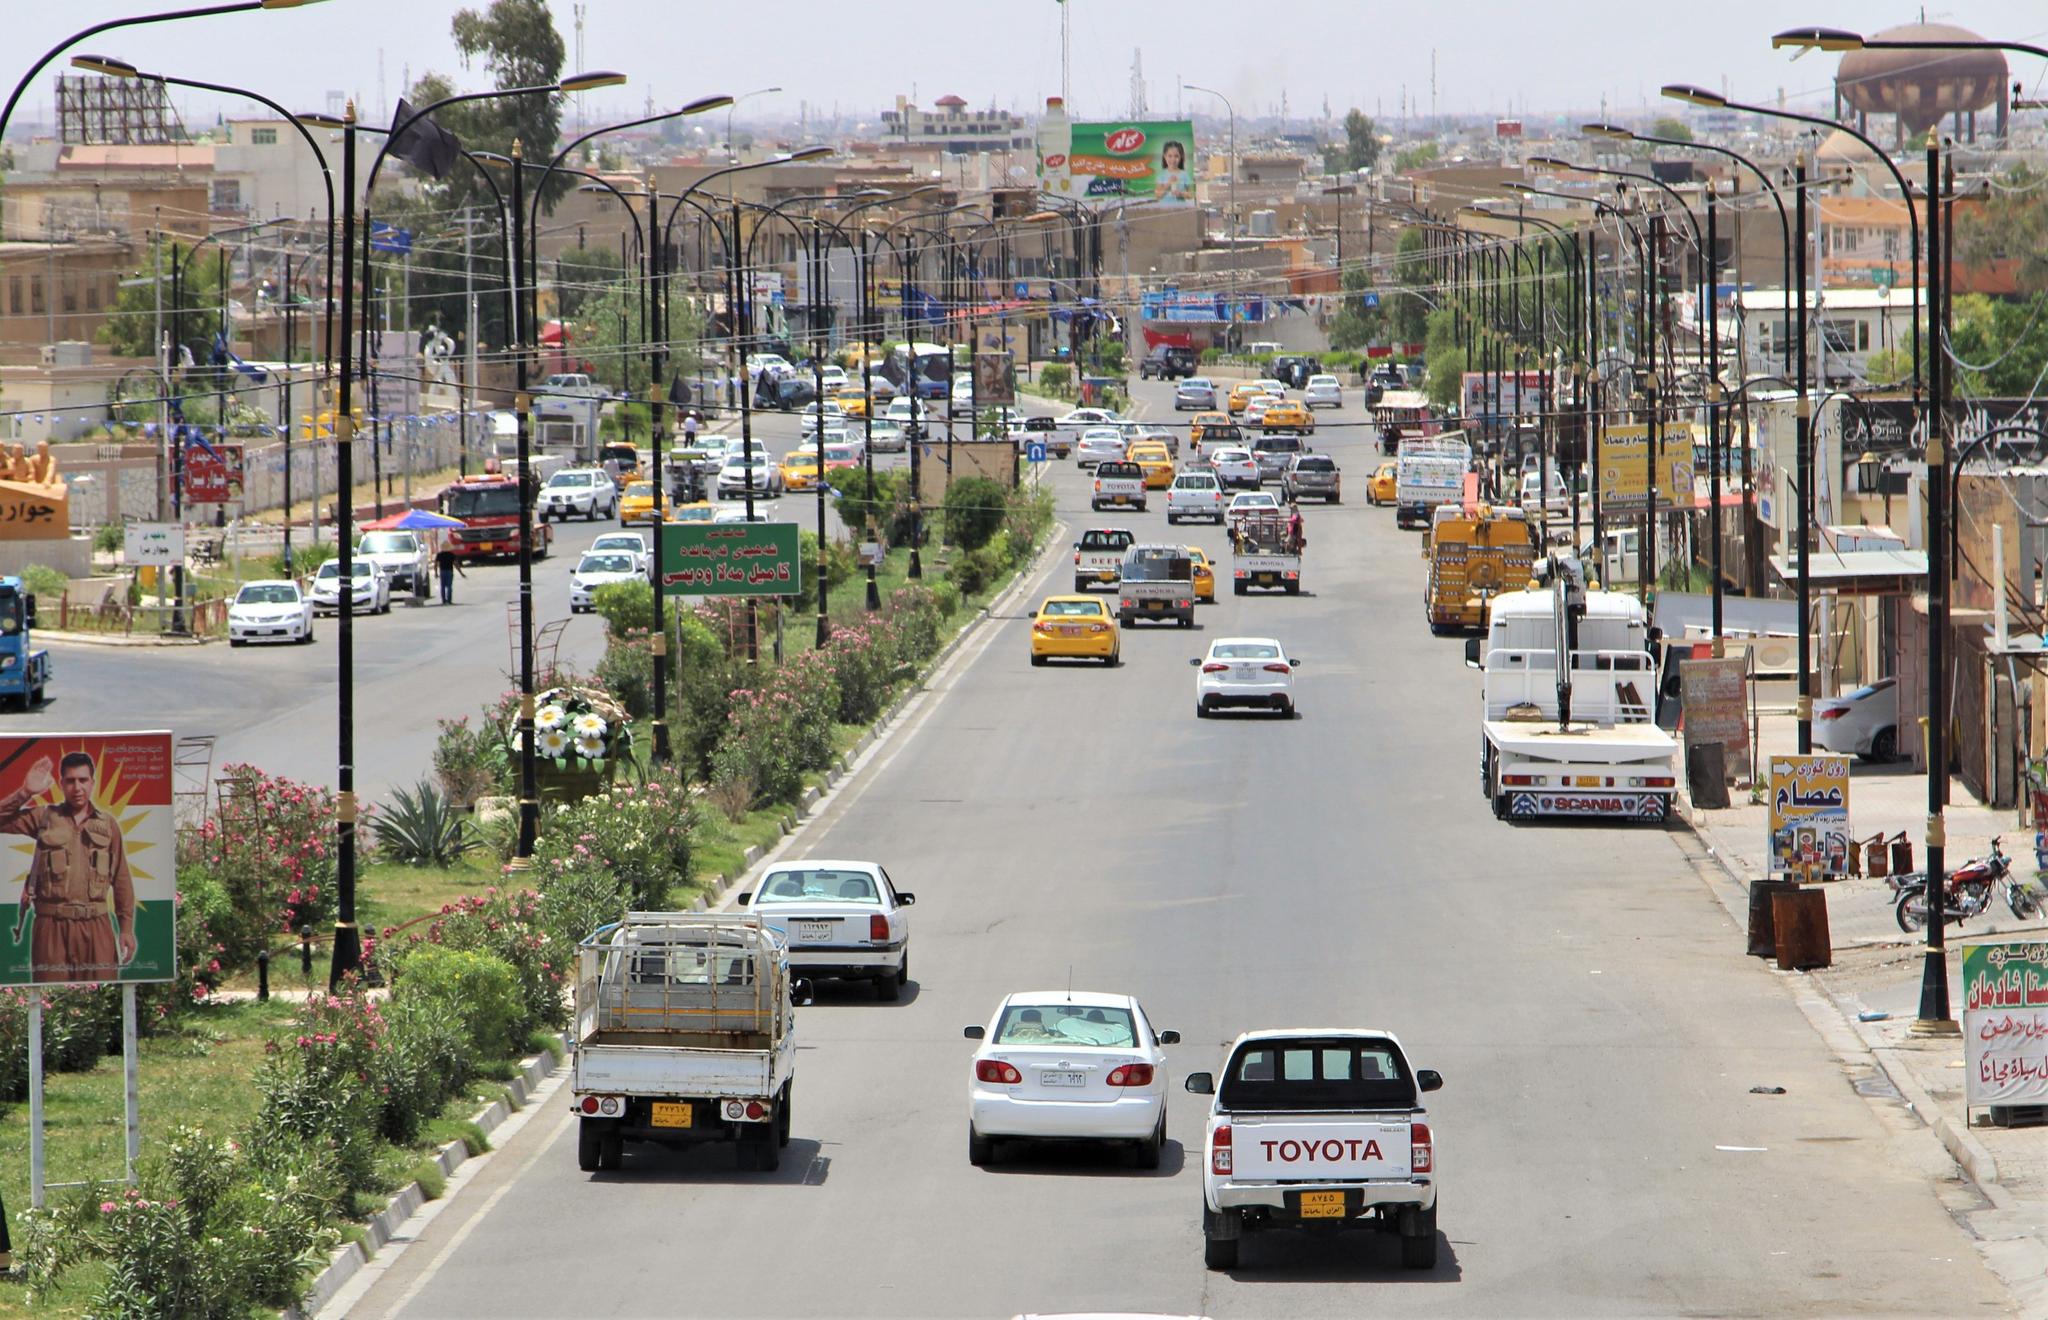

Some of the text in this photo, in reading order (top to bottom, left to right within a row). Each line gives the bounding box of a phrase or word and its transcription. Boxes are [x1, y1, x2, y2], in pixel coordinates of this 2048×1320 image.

[1553, 797, 1625, 812] SCANIA
[1776, 779, 1843, 815] عصام
[1260, 1139, 1384, 1162] TOYOTA
